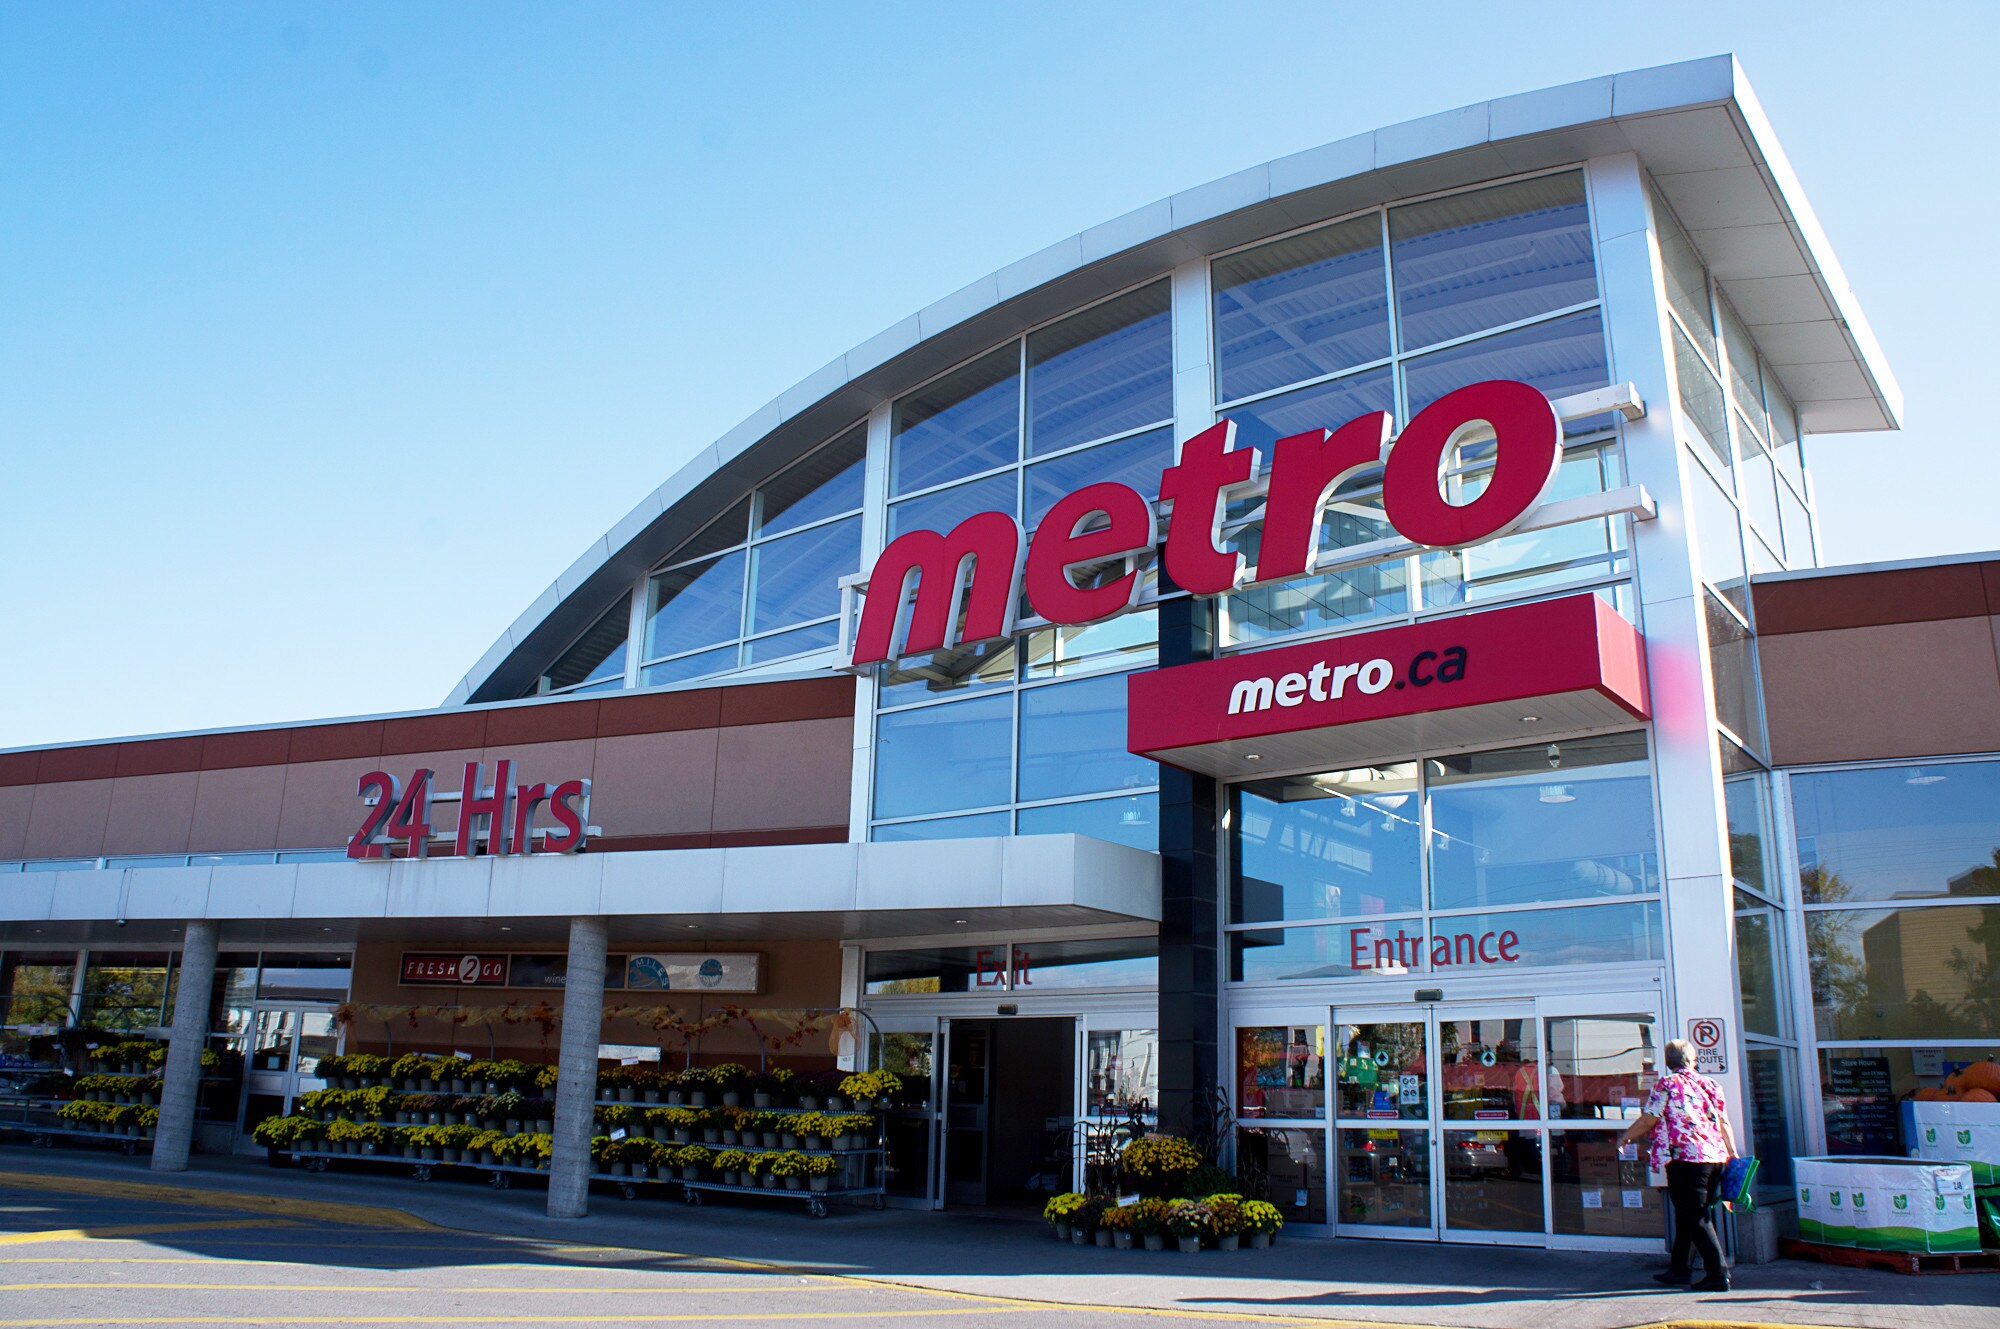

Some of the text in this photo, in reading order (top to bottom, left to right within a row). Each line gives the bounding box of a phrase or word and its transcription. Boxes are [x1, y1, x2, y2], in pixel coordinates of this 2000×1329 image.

[852, 379, 1562, 665] metro
[1227, 645, 1467, 715] metro.ca
[346, 759, 588, 858] 24 Hrs
[976, 949, 1032, 986] Exit
[1350, 928, 1520, 970] Entrance
[406, 958, 502, 981] FRESH 2 GO
[1695, 1055, 1724, 1064] ROUTE
[1697, 1048, 1718, 1056] FIRE
